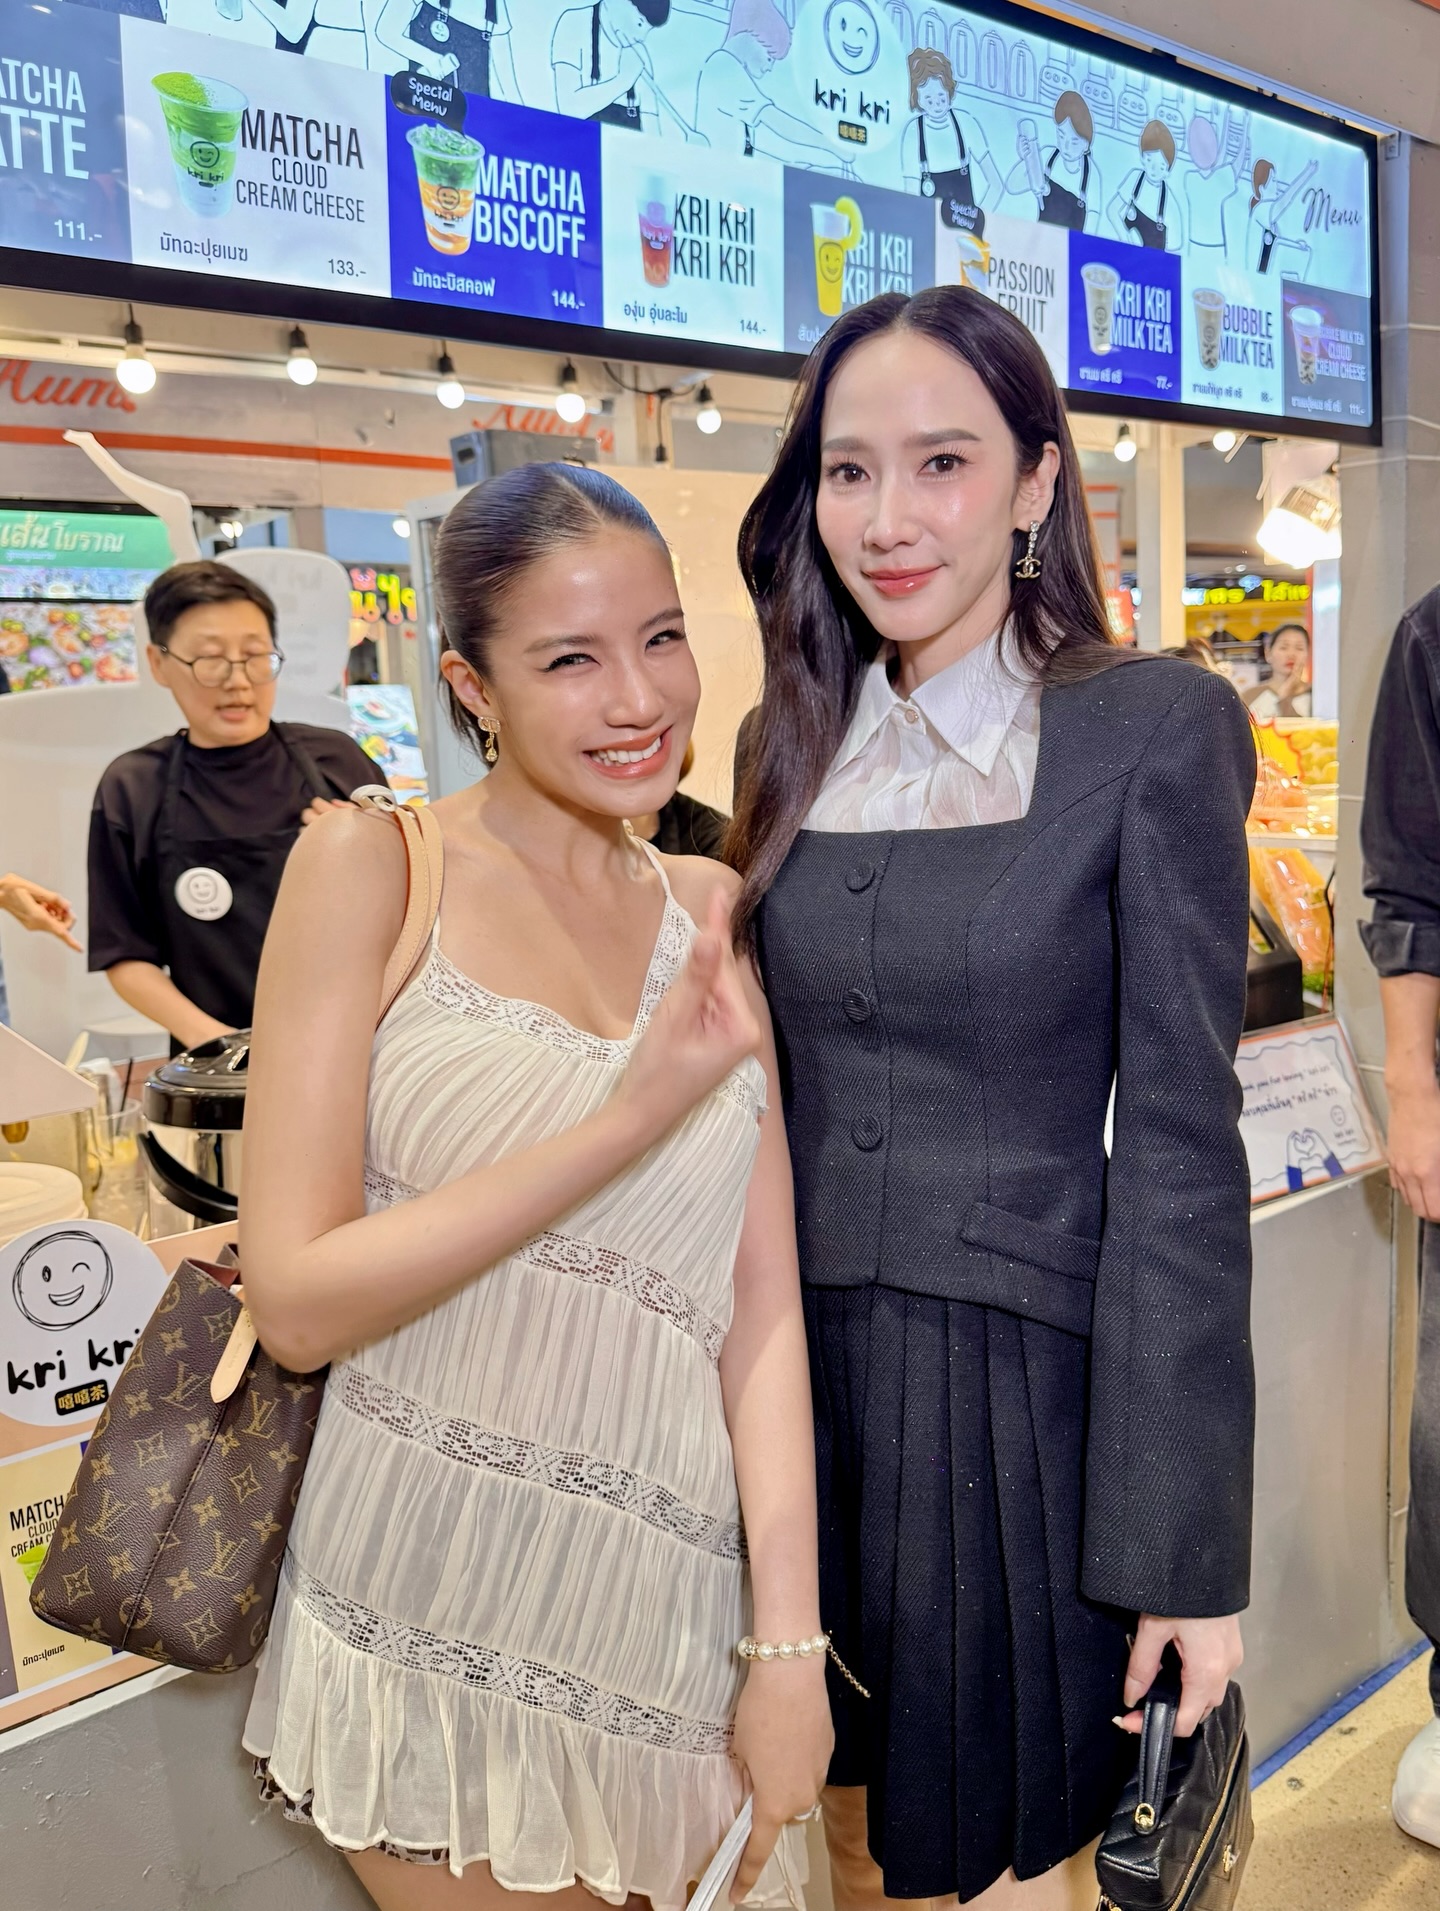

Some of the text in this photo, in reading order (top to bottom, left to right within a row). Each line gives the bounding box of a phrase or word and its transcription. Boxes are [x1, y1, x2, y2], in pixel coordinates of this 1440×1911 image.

[0, 57, 87, 114] TCHA
[408, 77, 453, 102] Special
[814, 78, 890, 125] kri kri
[0, 104, 89, 180] TTE
[241, 107, 365, 169] MATCHA
[271, 157, 328, 189] CLOUD
[475, 154, 586, 214] MATCHA
[235, 179, 366, 223] CREAM CHEESE
[674, 192, 755, 246] KRI KRI
[1302, 187, 1362, 233] Menu
[54, 219, 103, 242] 111.-
[160, 232, 248, 264] มัทฉะปุยเมฆ
[475, 203, 586, 258] BISCOFF
[328, 258, 367, 278] 133.-
[674, 236, 755, 287] KRI KRI
[880, 232, 913, 275] KRI
[842, 265, 875, 305] KRI
[989, 256, 1055, 298] PASSION
[551, 289, 586, 309] 144.-
[1116, 280, 1172, 323] KRI KRI
[1222, 303, 1273, 338] BUBBLE
[1110, 316, 1174, 354] MILK TEA
[1219, 336, 1275, 369] MILK TEA
[7, 1328, 141, 1395] kri kr
